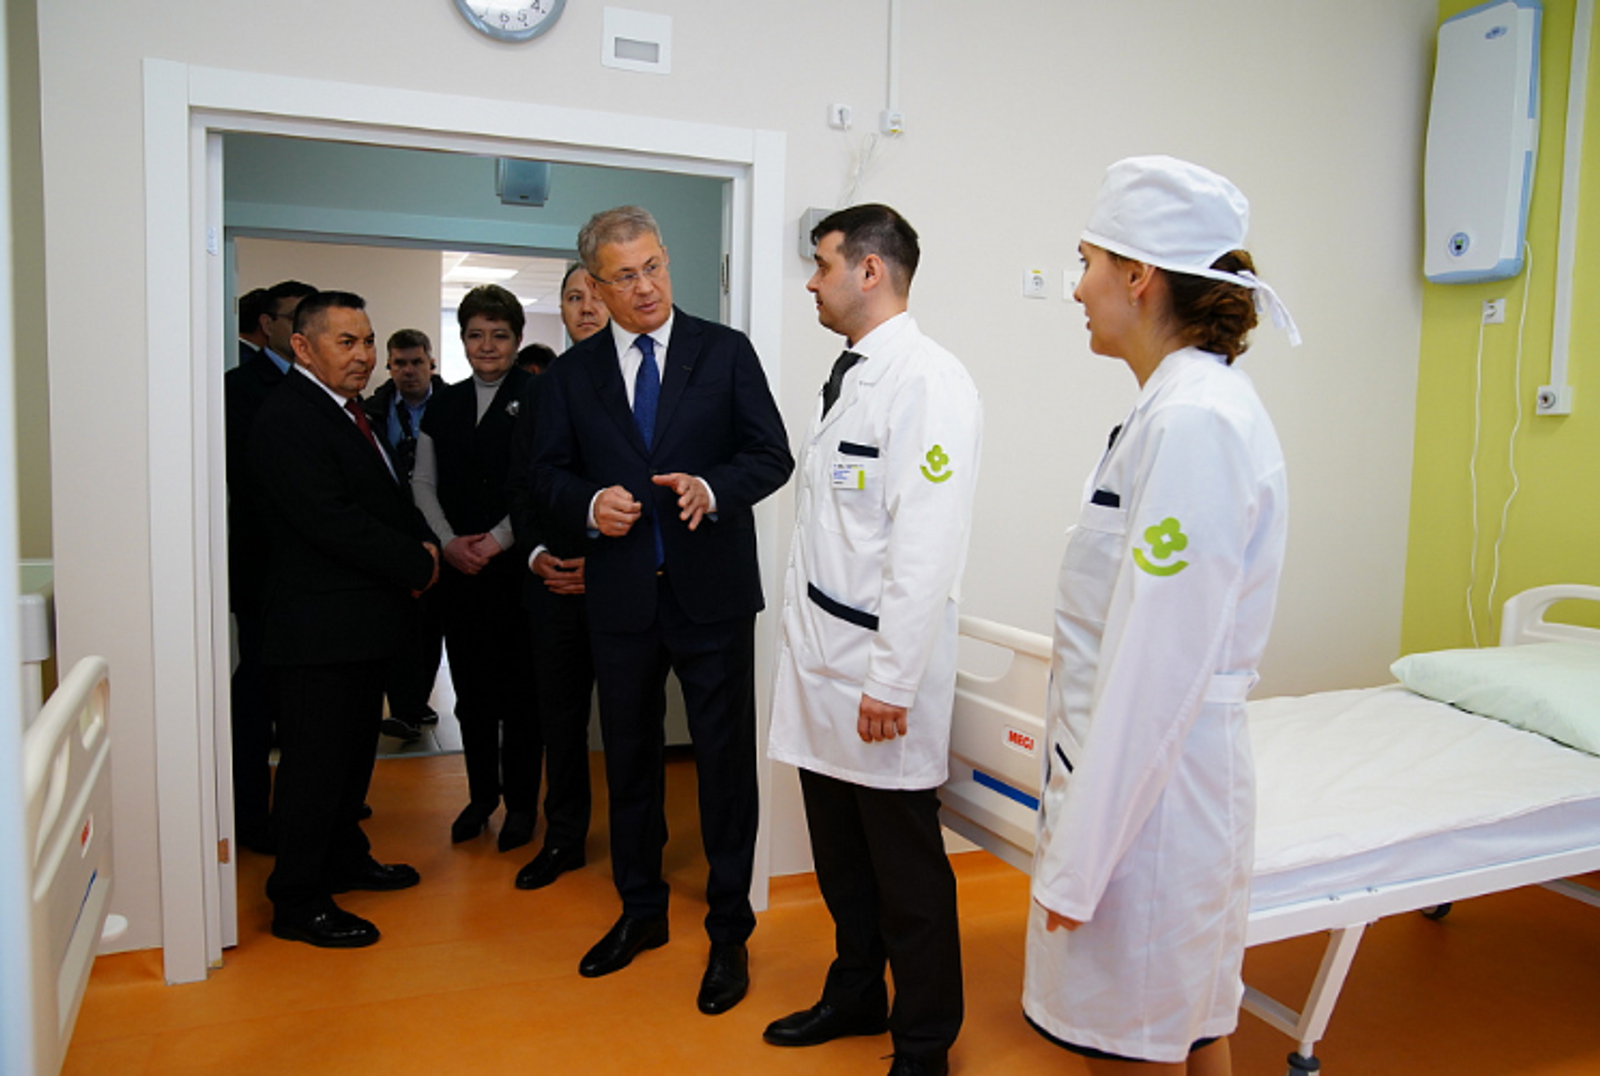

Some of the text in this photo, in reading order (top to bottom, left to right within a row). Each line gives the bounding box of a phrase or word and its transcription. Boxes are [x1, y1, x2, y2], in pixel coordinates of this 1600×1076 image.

[531, 0, 541, 10] 4
[500, 9, 510, 22] 6
[518, 9, 527, 22] 5
